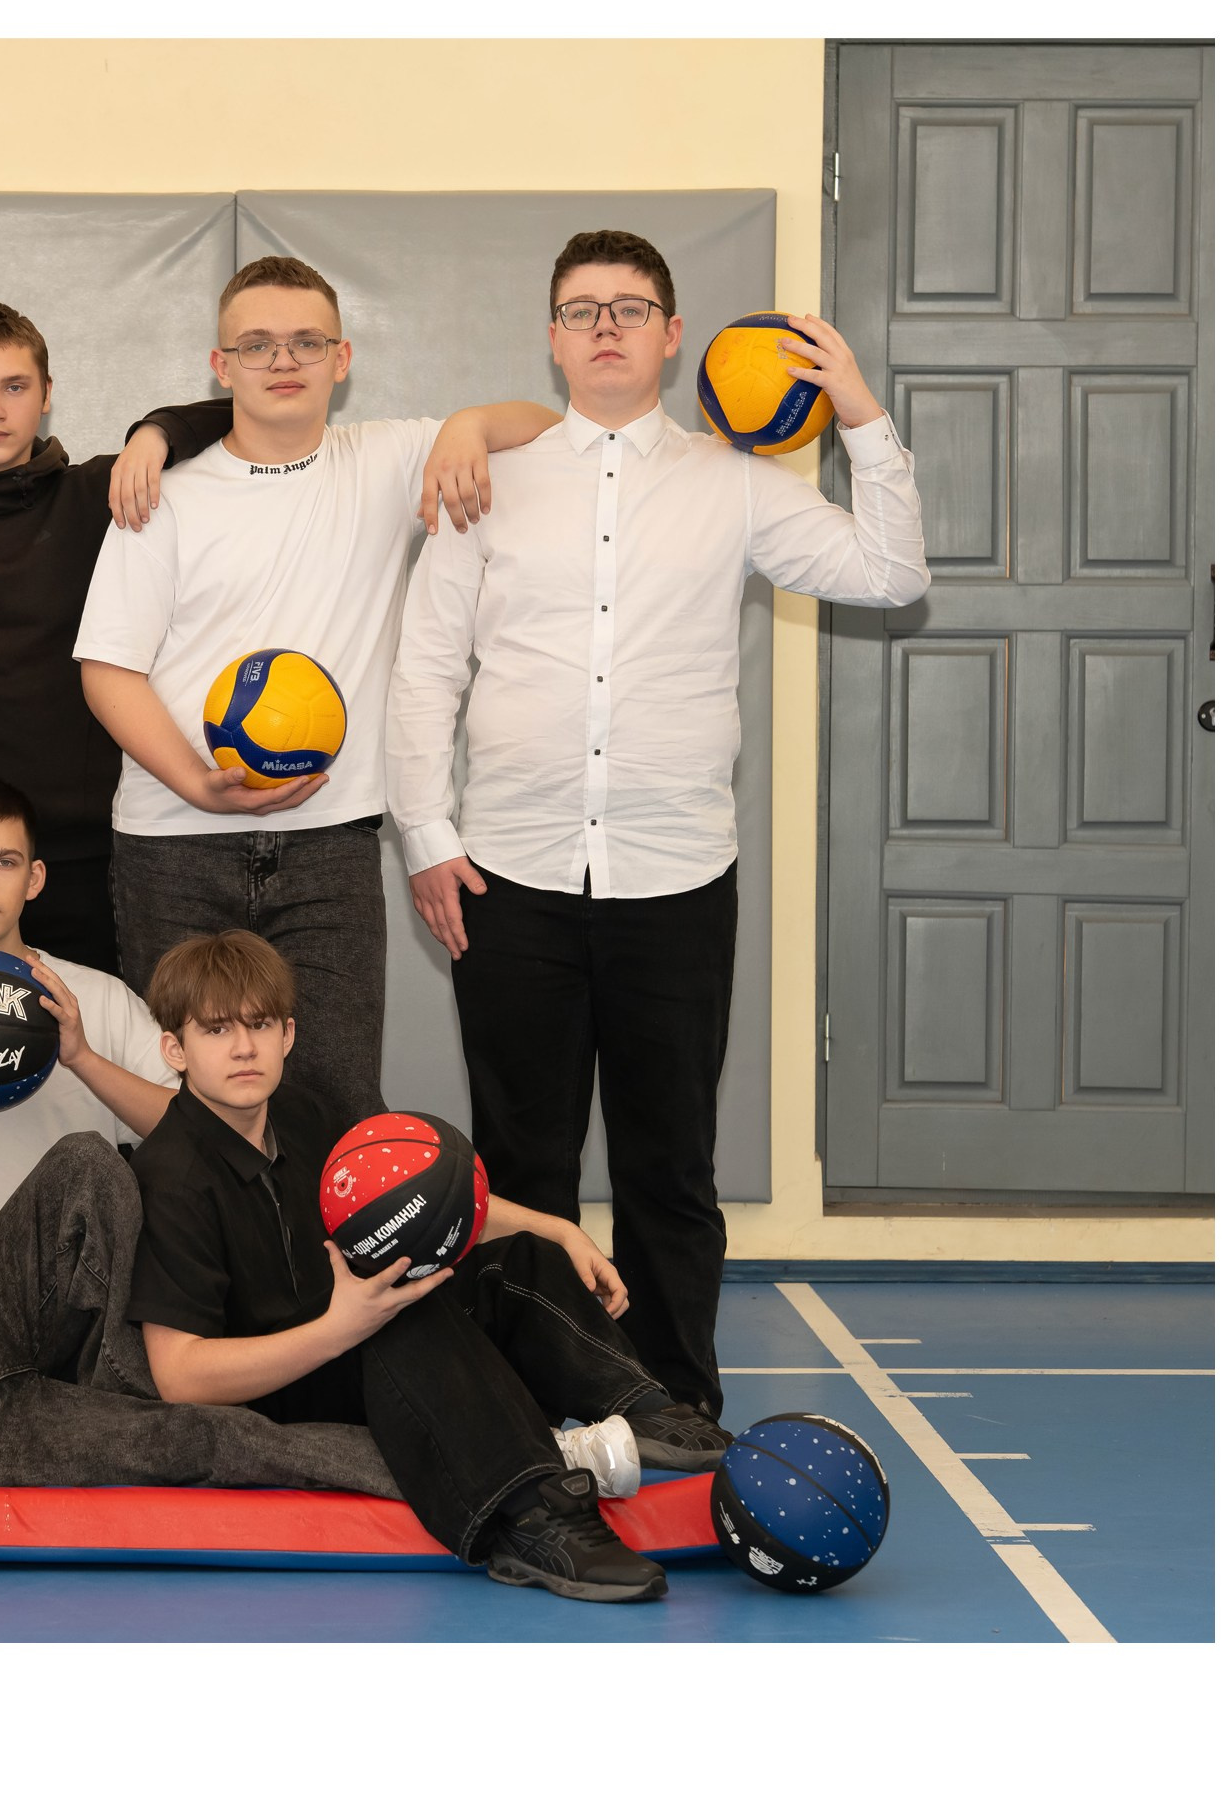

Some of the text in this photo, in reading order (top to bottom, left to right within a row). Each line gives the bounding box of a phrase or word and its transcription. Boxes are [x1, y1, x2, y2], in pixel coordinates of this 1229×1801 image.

[250, 453, 318, 475] Palm Angels
[261, 759, 313, 771] MIKASA
[353, 1235, 380, 1255] ОДНА
[374, 1194, 427, 1242] КОМАНДА!
